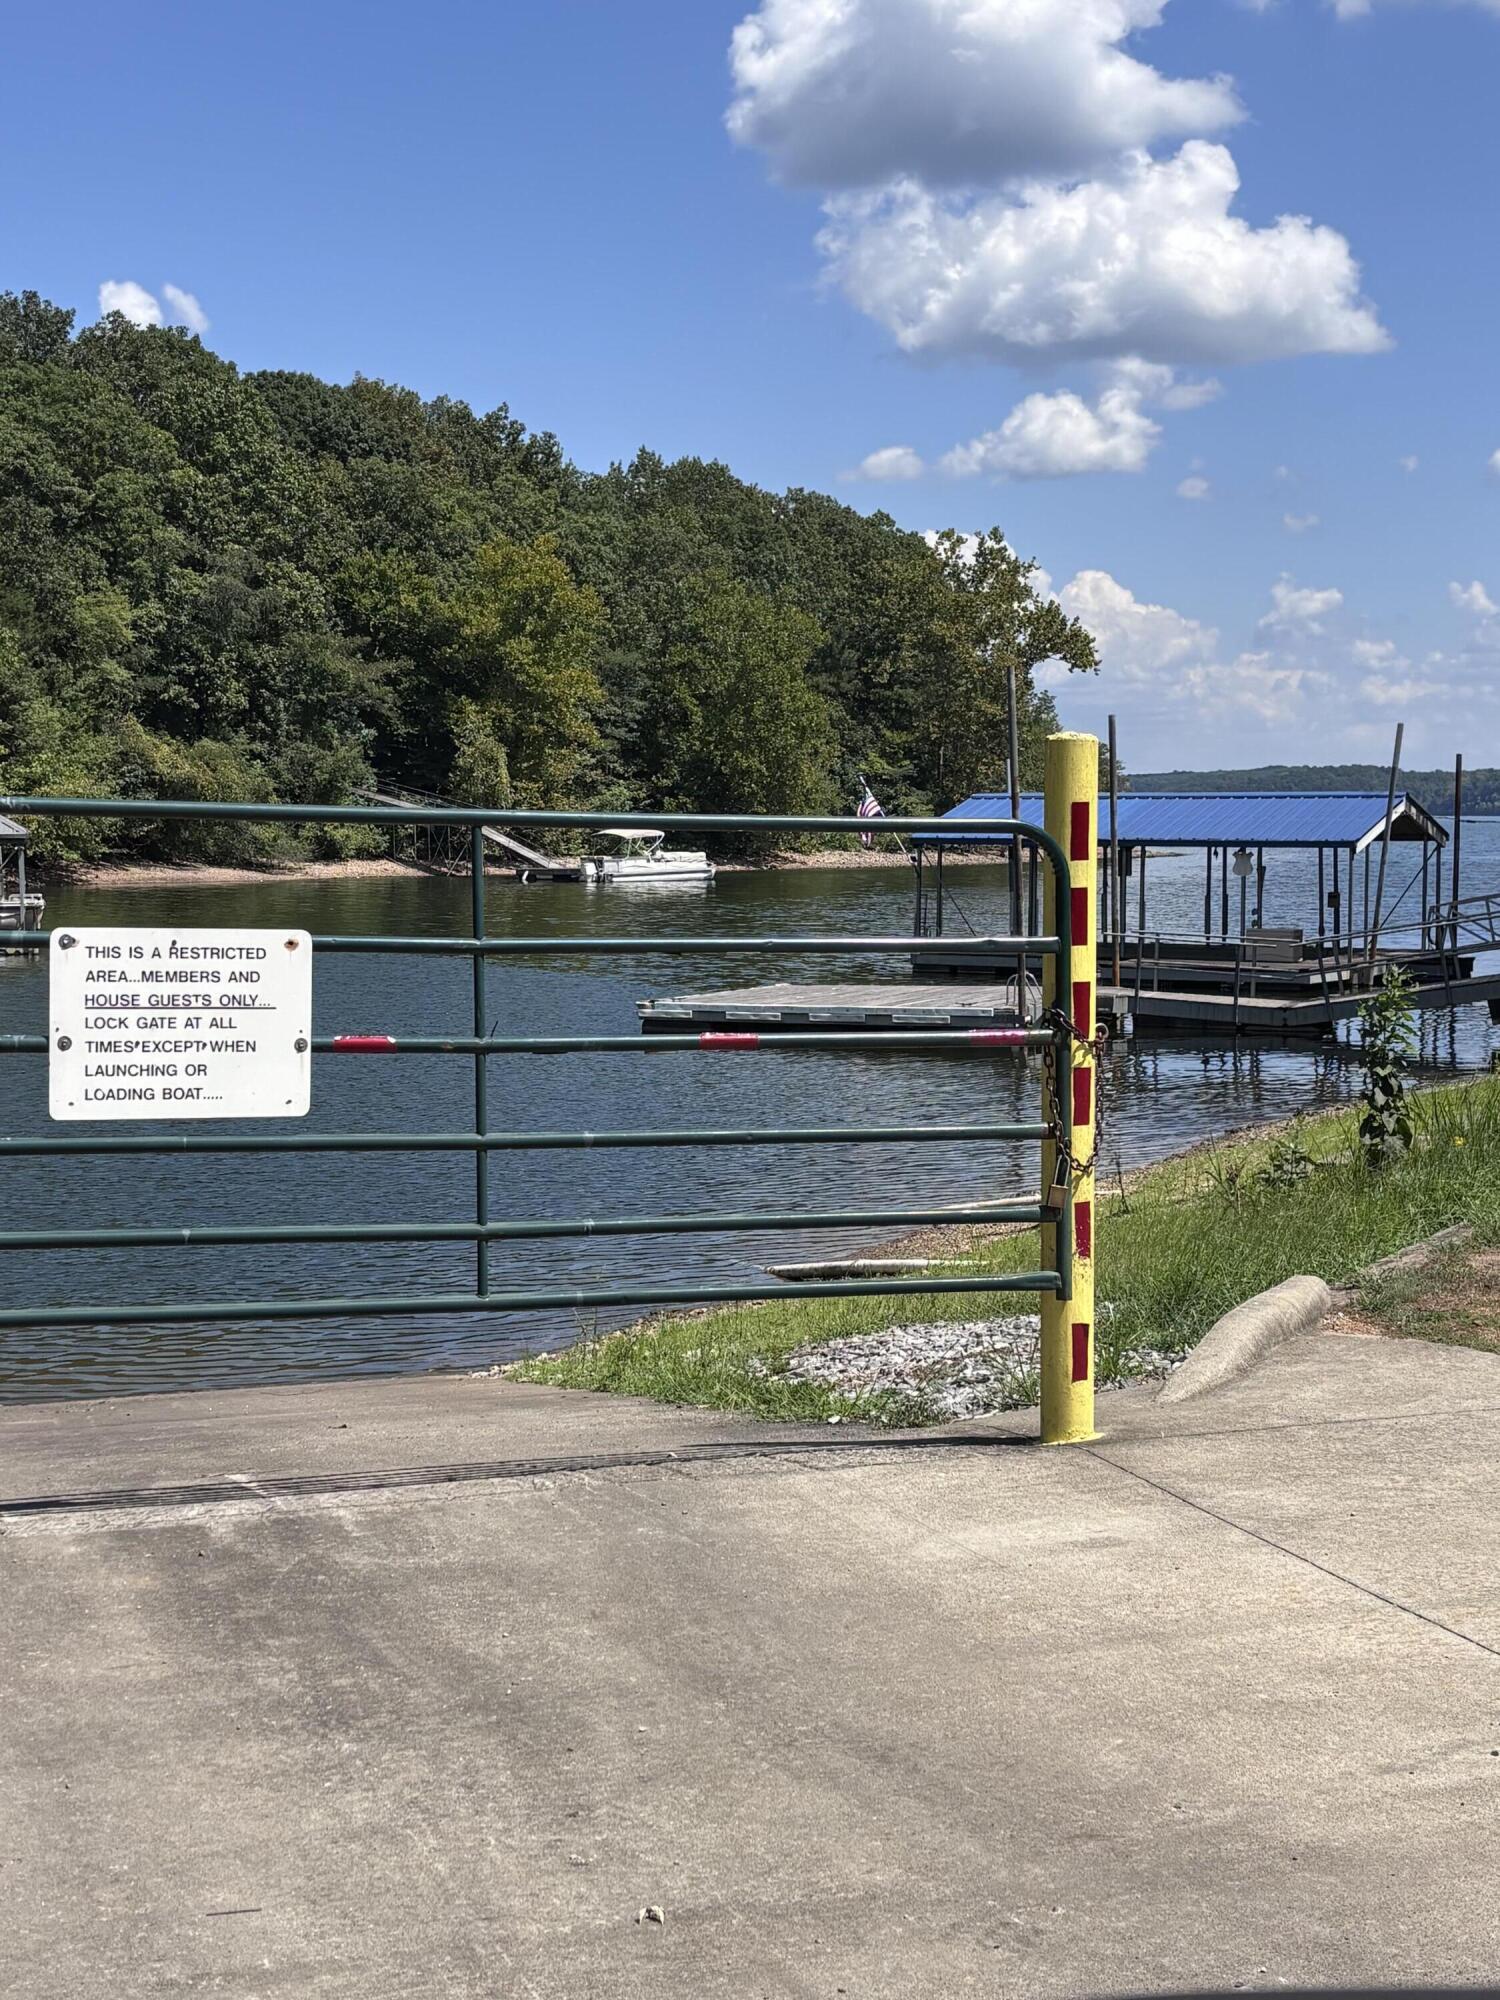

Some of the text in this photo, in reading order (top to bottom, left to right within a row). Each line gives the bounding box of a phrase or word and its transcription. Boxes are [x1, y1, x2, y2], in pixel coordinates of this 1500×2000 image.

[86, 946, 266, 960] THIS IS A RESTRICTED
[228, 971, 260, 983] AND
[85, 994, 140, 1007] HOUSE
[148, 994, 212, 1007] GUESTS
[85, 1017, 237, 1029] LOCK GATE AT ALL
[85, 1041, 256, 1053] TIMES EXCEPT WHEN
[85, 1064, 208, 1077] LAUNCHING OR
[85, 1088, 155, 1101] LOADING
